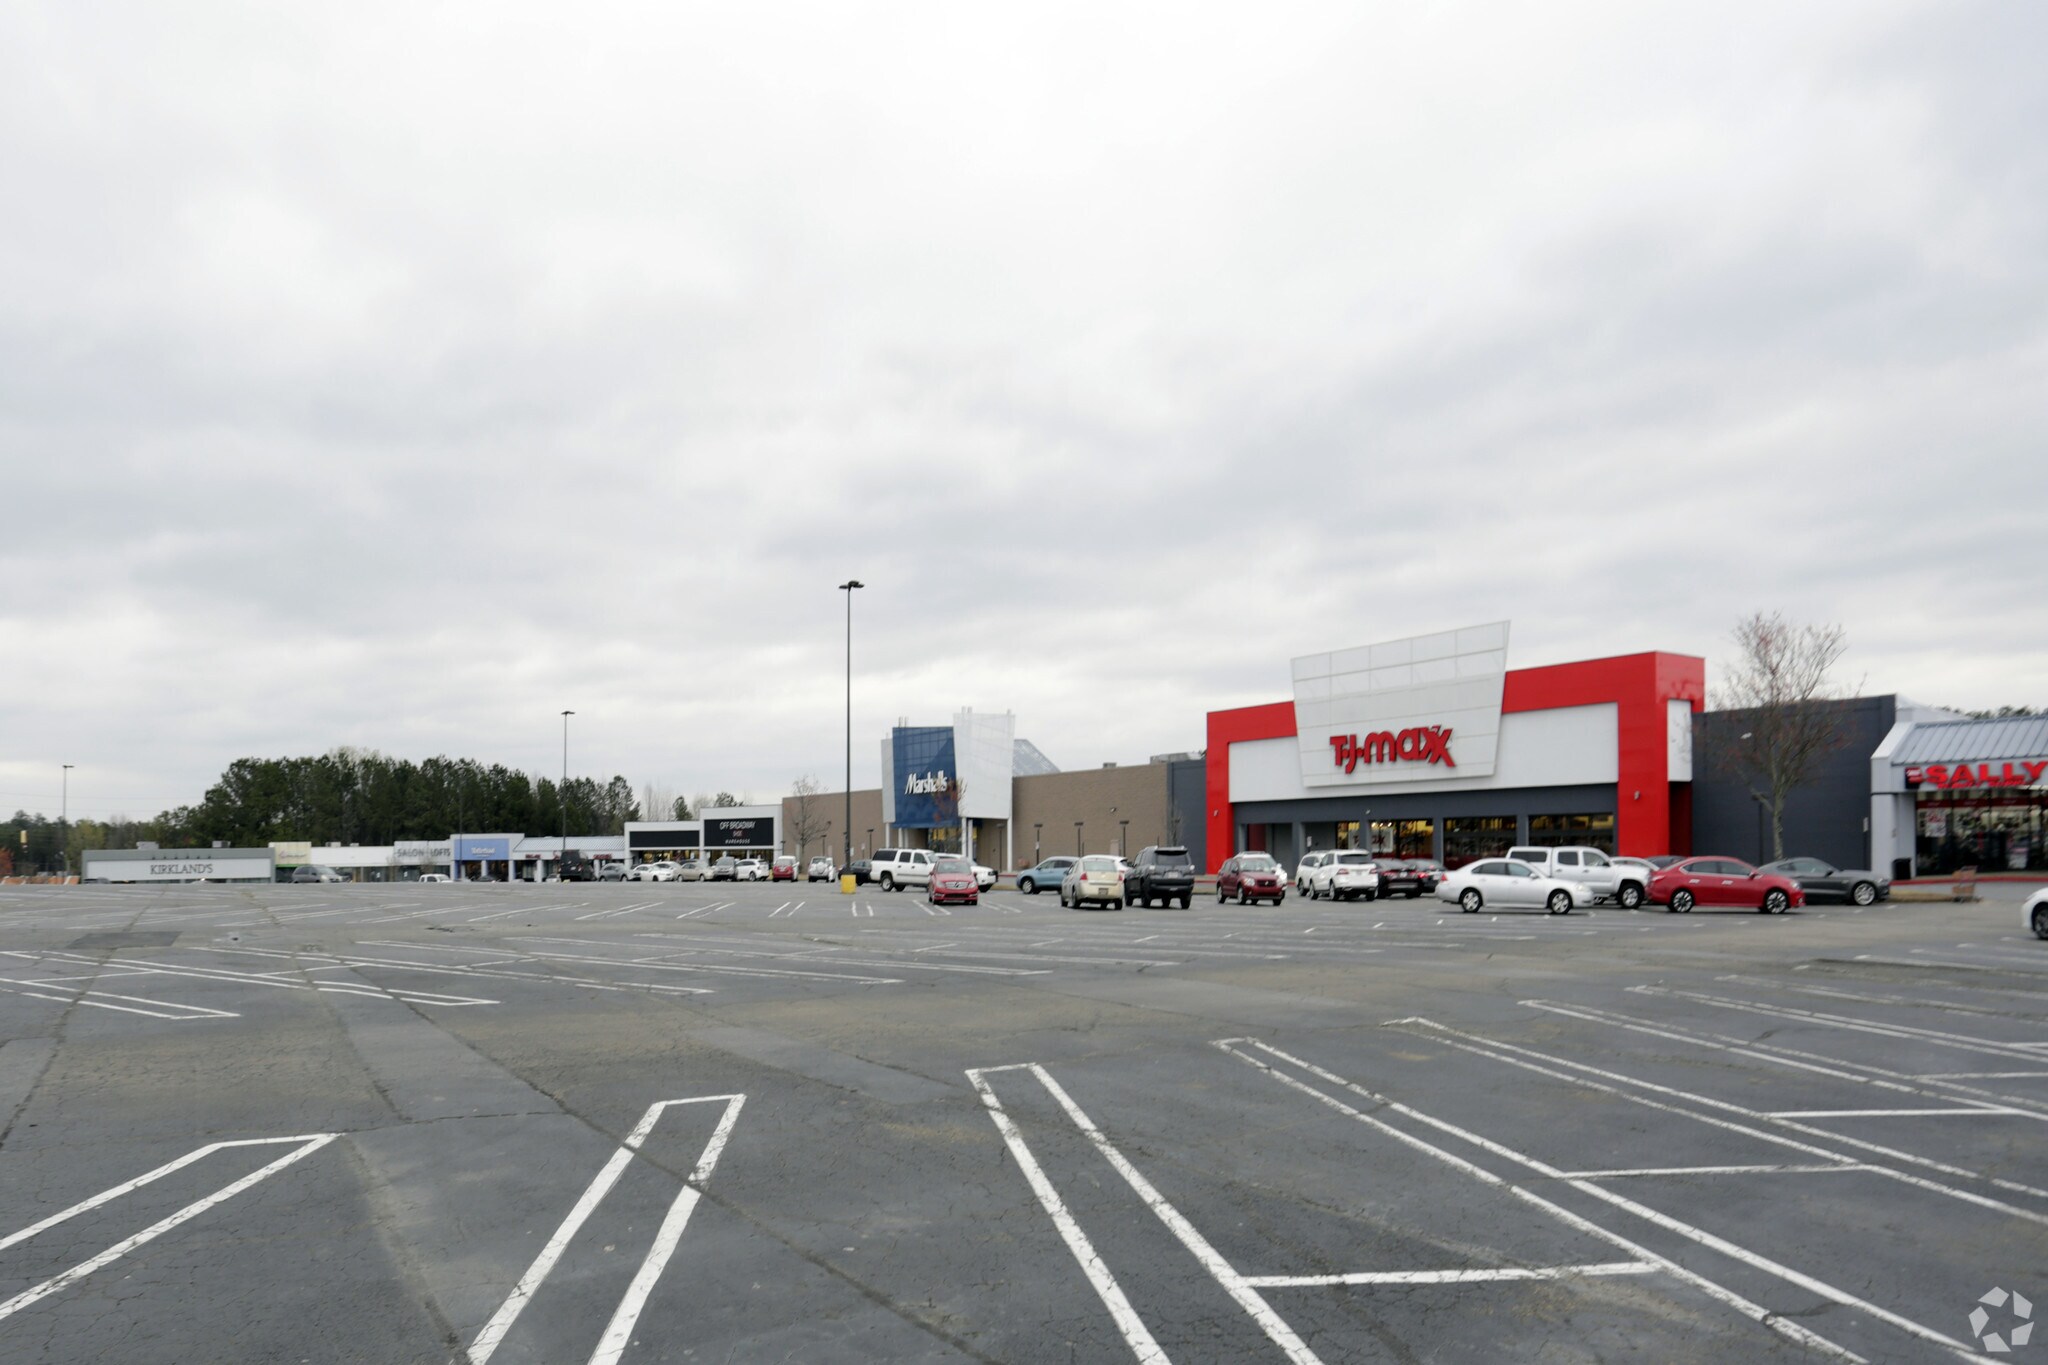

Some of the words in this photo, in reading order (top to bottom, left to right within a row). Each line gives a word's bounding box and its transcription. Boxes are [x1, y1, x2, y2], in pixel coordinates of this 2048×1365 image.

[1926, 761, 2048, 784] SALLY
[397, 848, 424, 857] SALON
[150, 863, 214, 875] KIRKLAND'S
